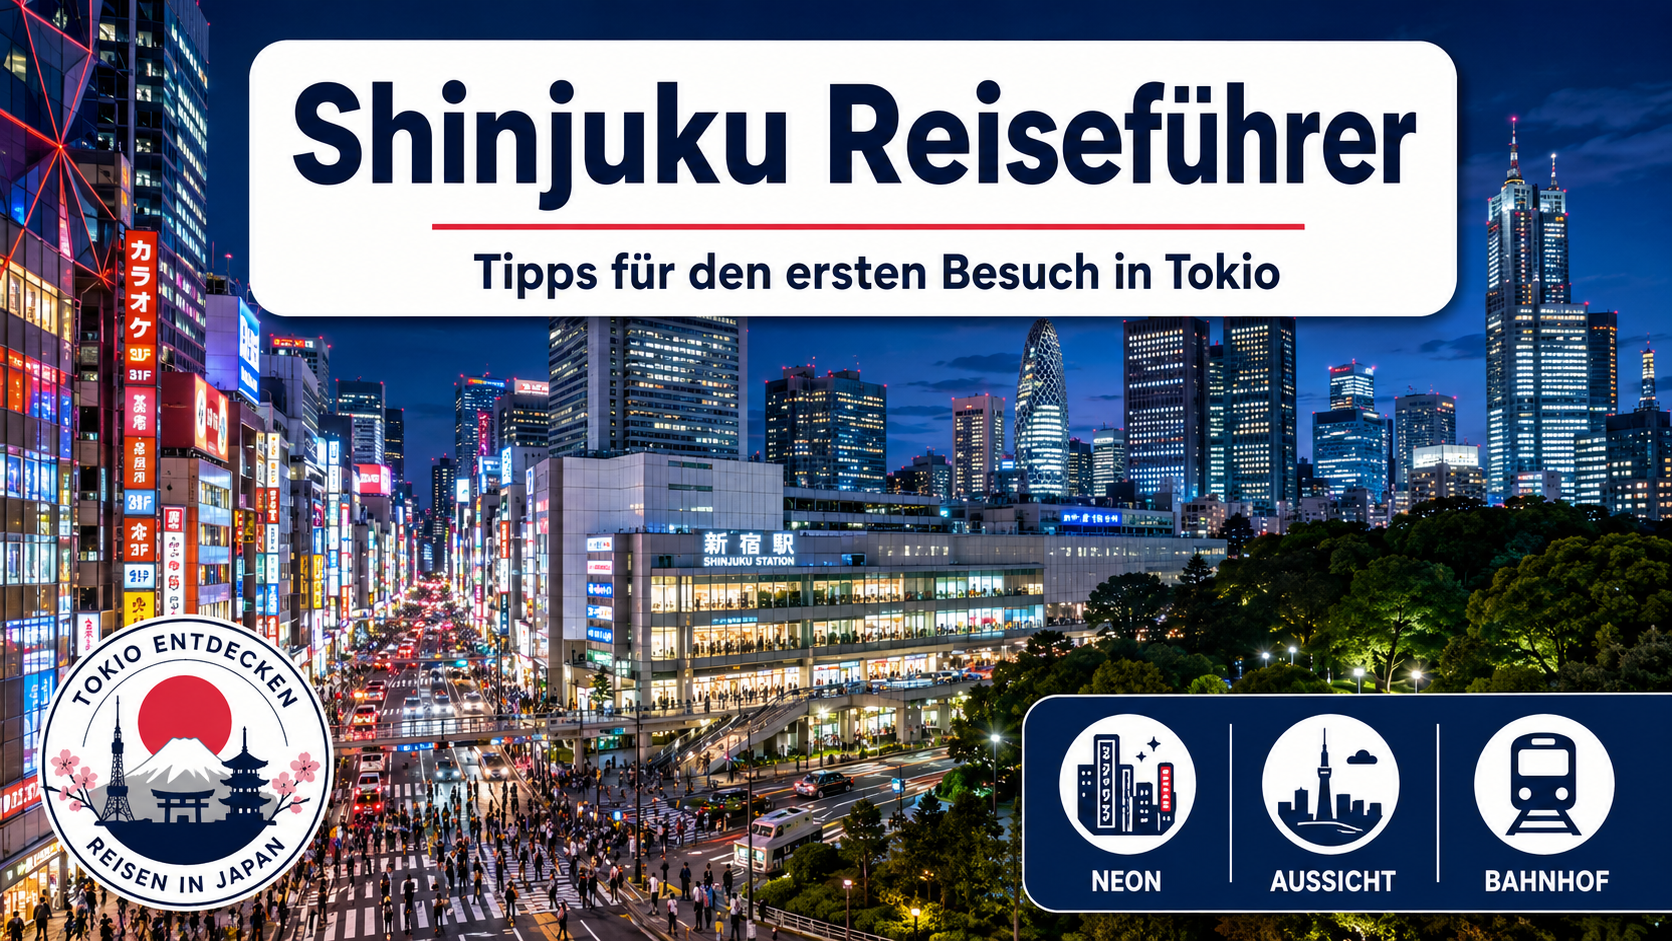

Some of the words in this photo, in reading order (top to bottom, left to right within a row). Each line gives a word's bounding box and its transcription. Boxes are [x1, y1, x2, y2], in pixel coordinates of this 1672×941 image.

[130, 239, 152, 338] カラオケ
[704, 531, 794, 555] 新宿駅
[703, 556, 752, 566] SHINJUKU
[756, 556, 795, 566] STATION
